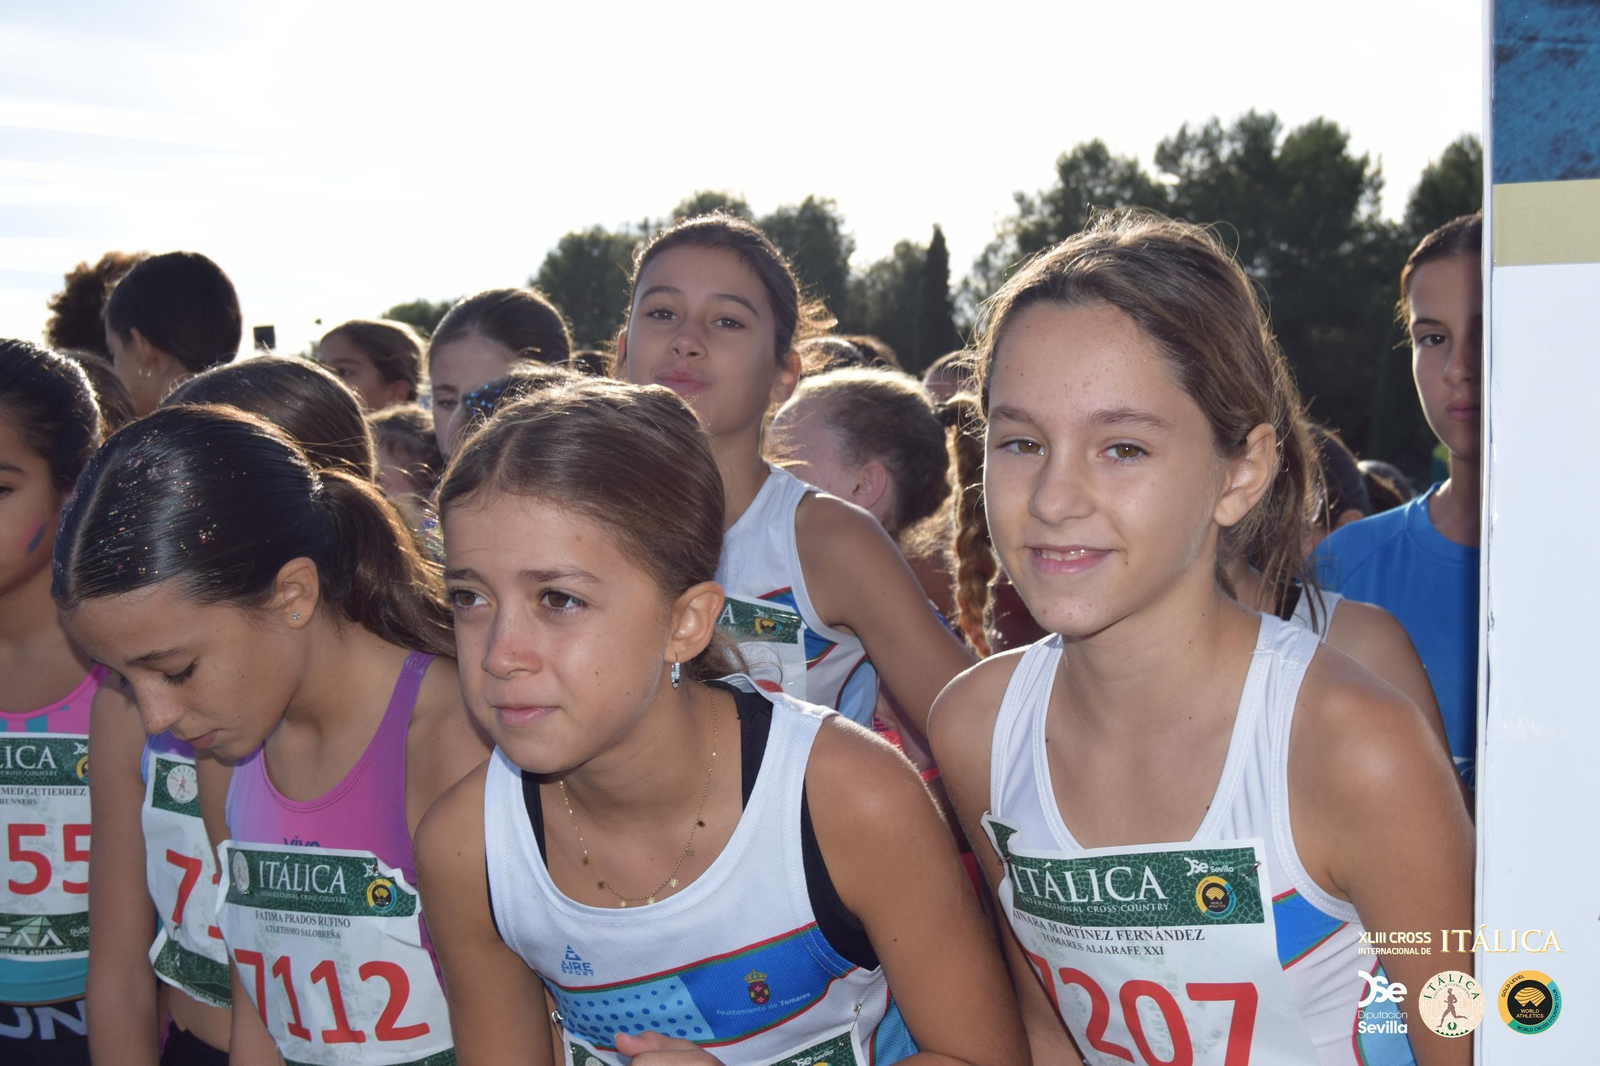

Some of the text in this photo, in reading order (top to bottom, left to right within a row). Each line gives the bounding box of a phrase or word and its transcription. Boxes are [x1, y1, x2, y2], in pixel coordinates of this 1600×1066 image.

[0, 745, 57, 769] ICA
[26, 788, 86, 796] GUTIERREZ
[259, 856, 347, 895] ITÁLICA
[1011, 862, 1168, 902] ITÁLICA
[1020, 896, 1169, 913] INTERNATIONAL CROSS COUNTRY
[255, 908, 351, 928] FÁTIMA PRADOS RUFINO
[265, 924, 341, 940] ATLETISMO SALOBREÑA
[1048, 922, 1113, 940] MARTÍNEZ
[1116, 926, 1205, 941] FERNÁNDEZ
[1041, 932, 1164, 955] TOMARES ALJARAFE XXI
[562, 961, 593, 971] AIRE
[234, 949, 430, 1044] 7112
[716, 1006, 767, 1016] Ayuntamiento
[780, 993, 811, 1006] Tomares
